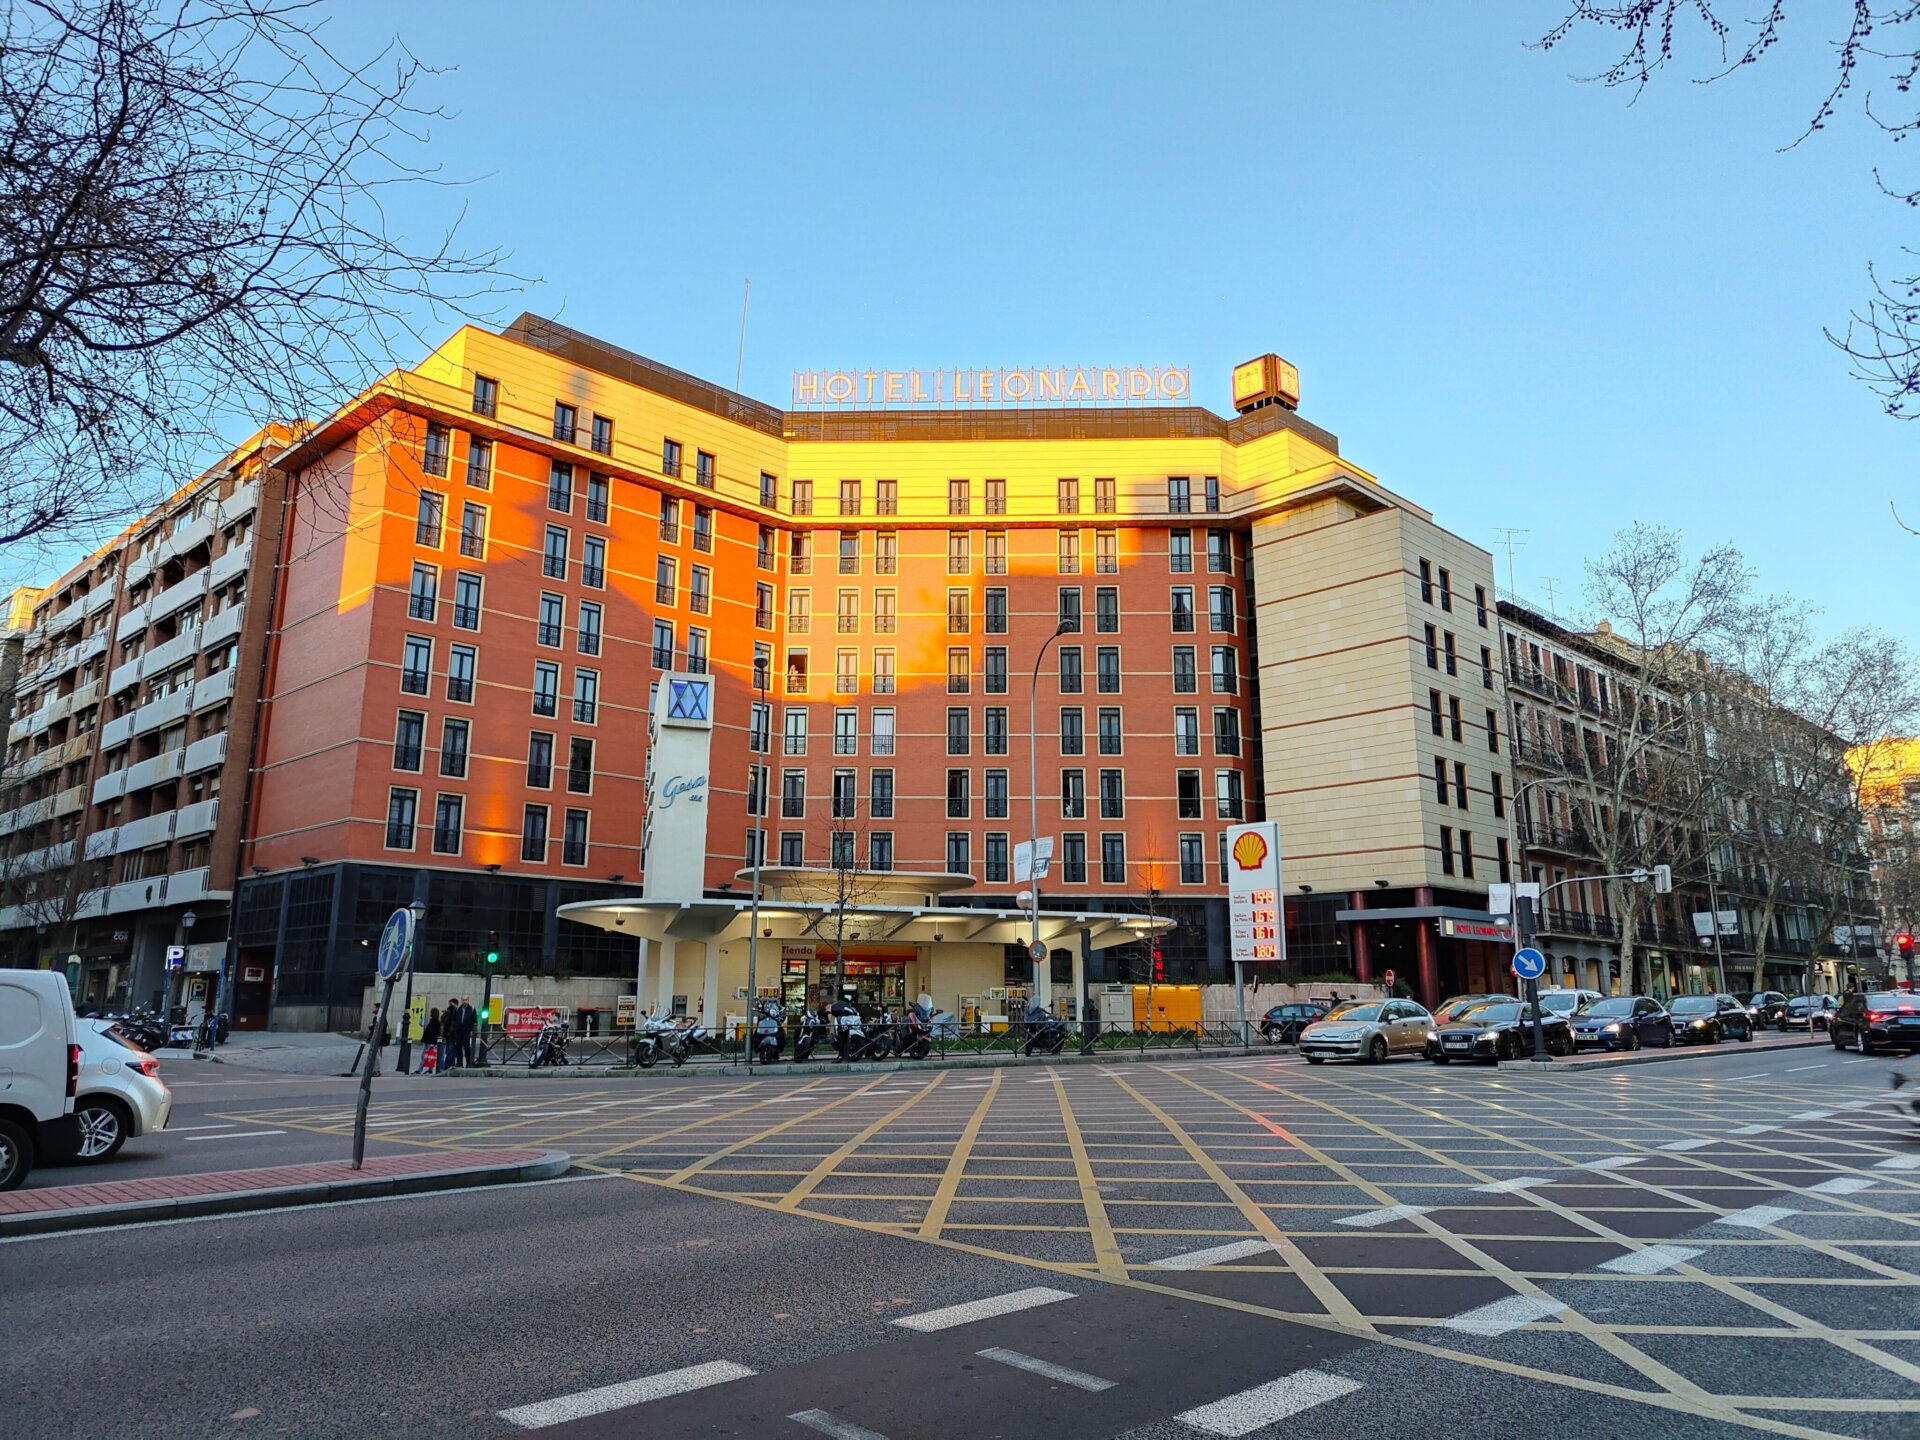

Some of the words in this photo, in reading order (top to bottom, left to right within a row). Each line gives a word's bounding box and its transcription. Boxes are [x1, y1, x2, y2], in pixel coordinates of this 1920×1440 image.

[799, 373, 928, 401] HOTEL
[955, 370, 1188, 399] LEONARDO
[168, 947, 185, 966] P
[782, 946, 813, 955] Tienda
[192, 983, 205, 996] P
